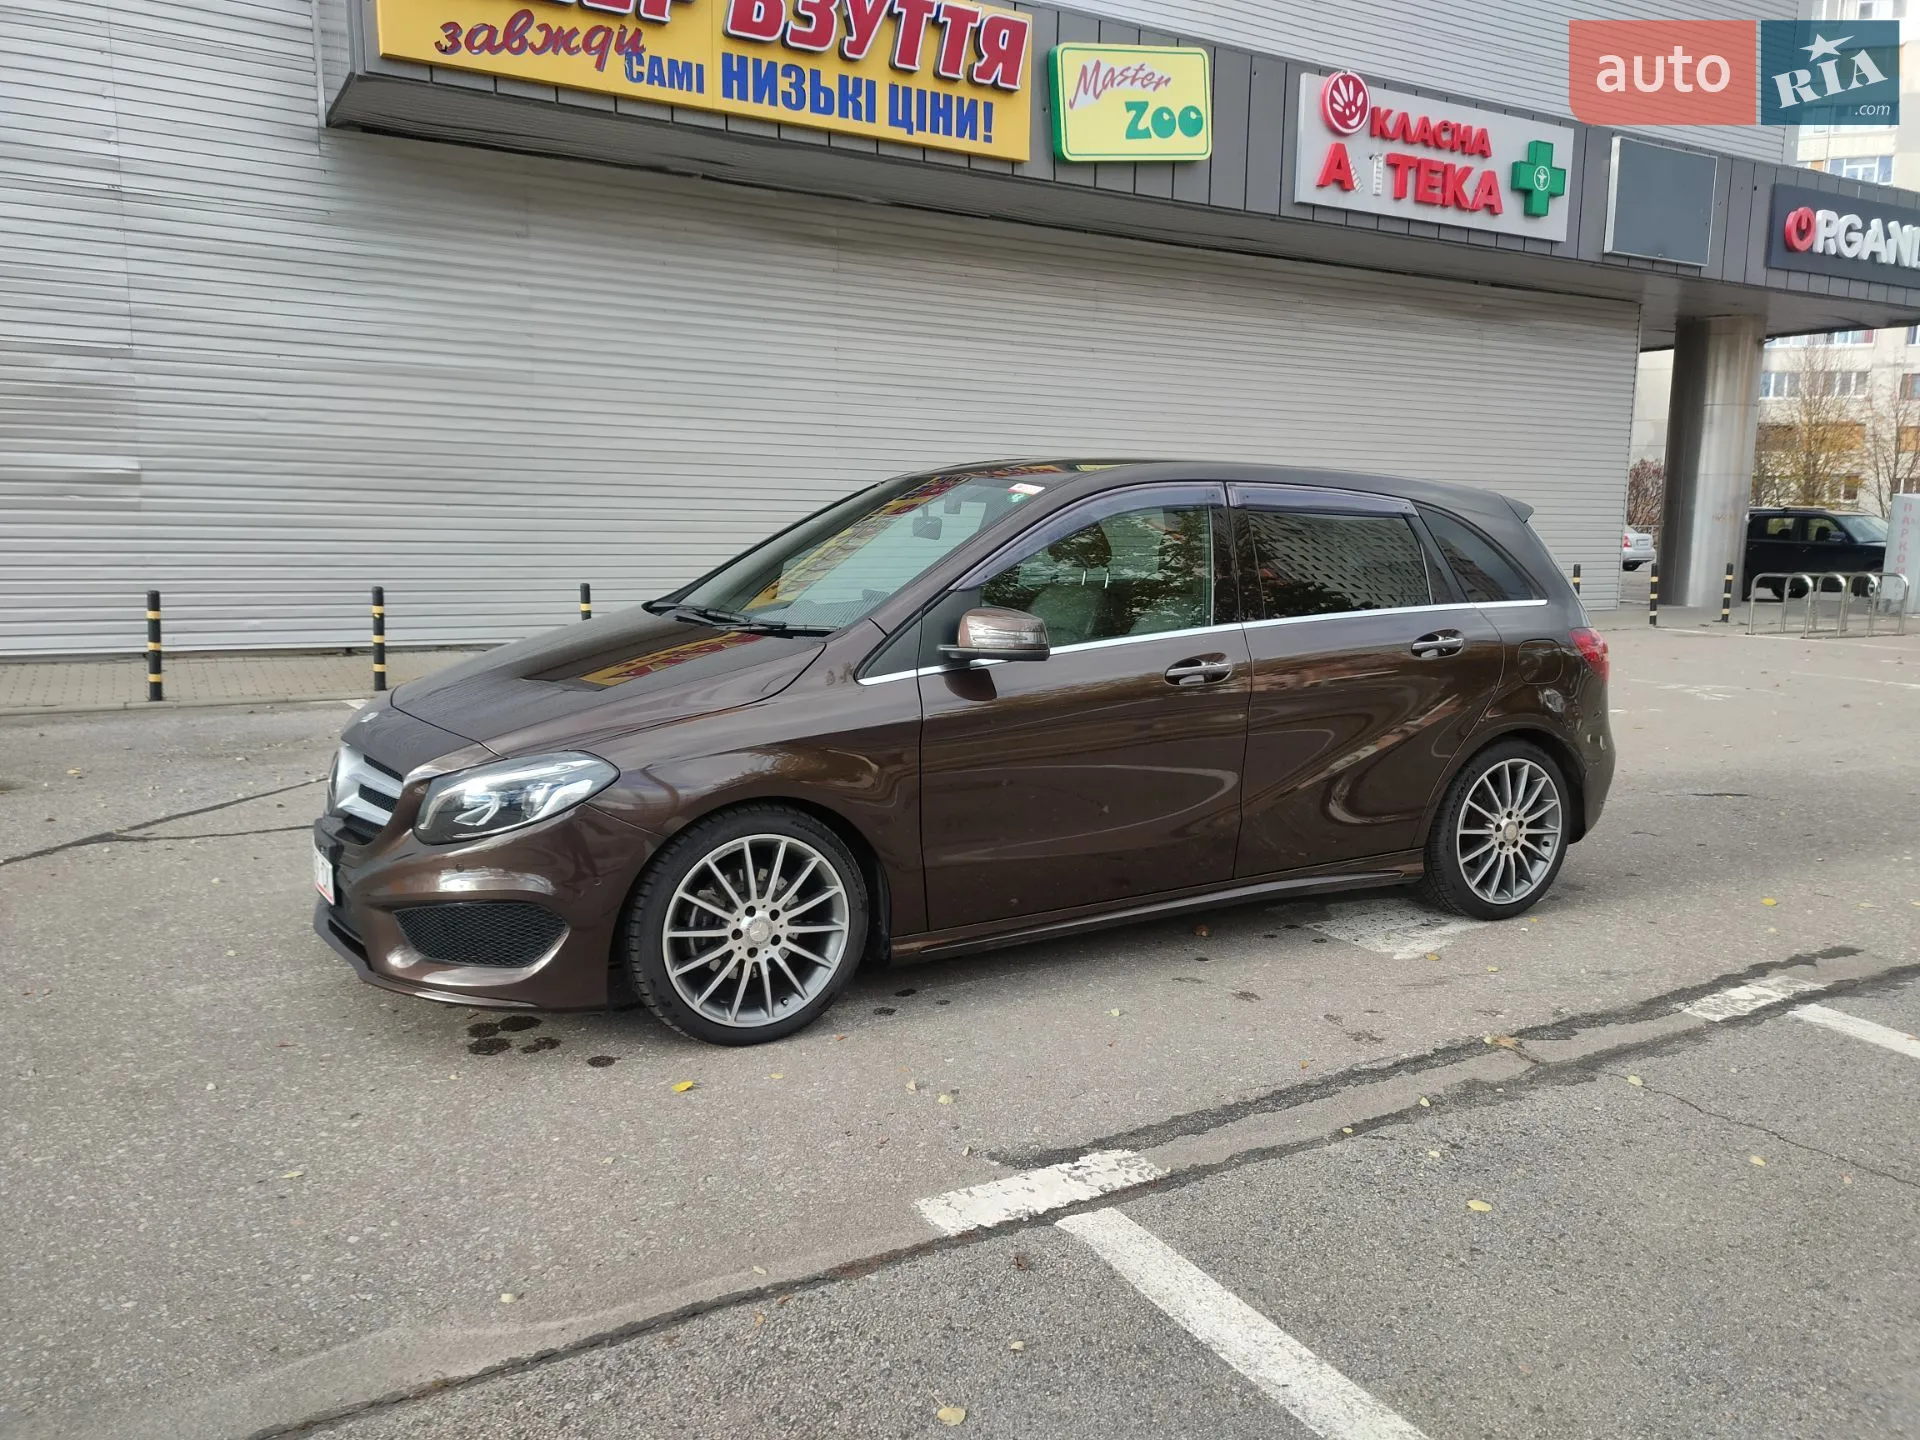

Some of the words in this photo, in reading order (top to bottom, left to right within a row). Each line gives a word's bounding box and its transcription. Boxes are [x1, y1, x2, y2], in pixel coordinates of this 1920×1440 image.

[434, 9, 646, 72] завжди
[624, 49, 704, 95] САМІ
[721, 52, 877, 125] НИЗЬКІ
[888, 82, 994, 143] ЦІНИ!
[1069, 59, 1171, 110] Master
[1369, 106, 1493, 158] КЛАСНА
